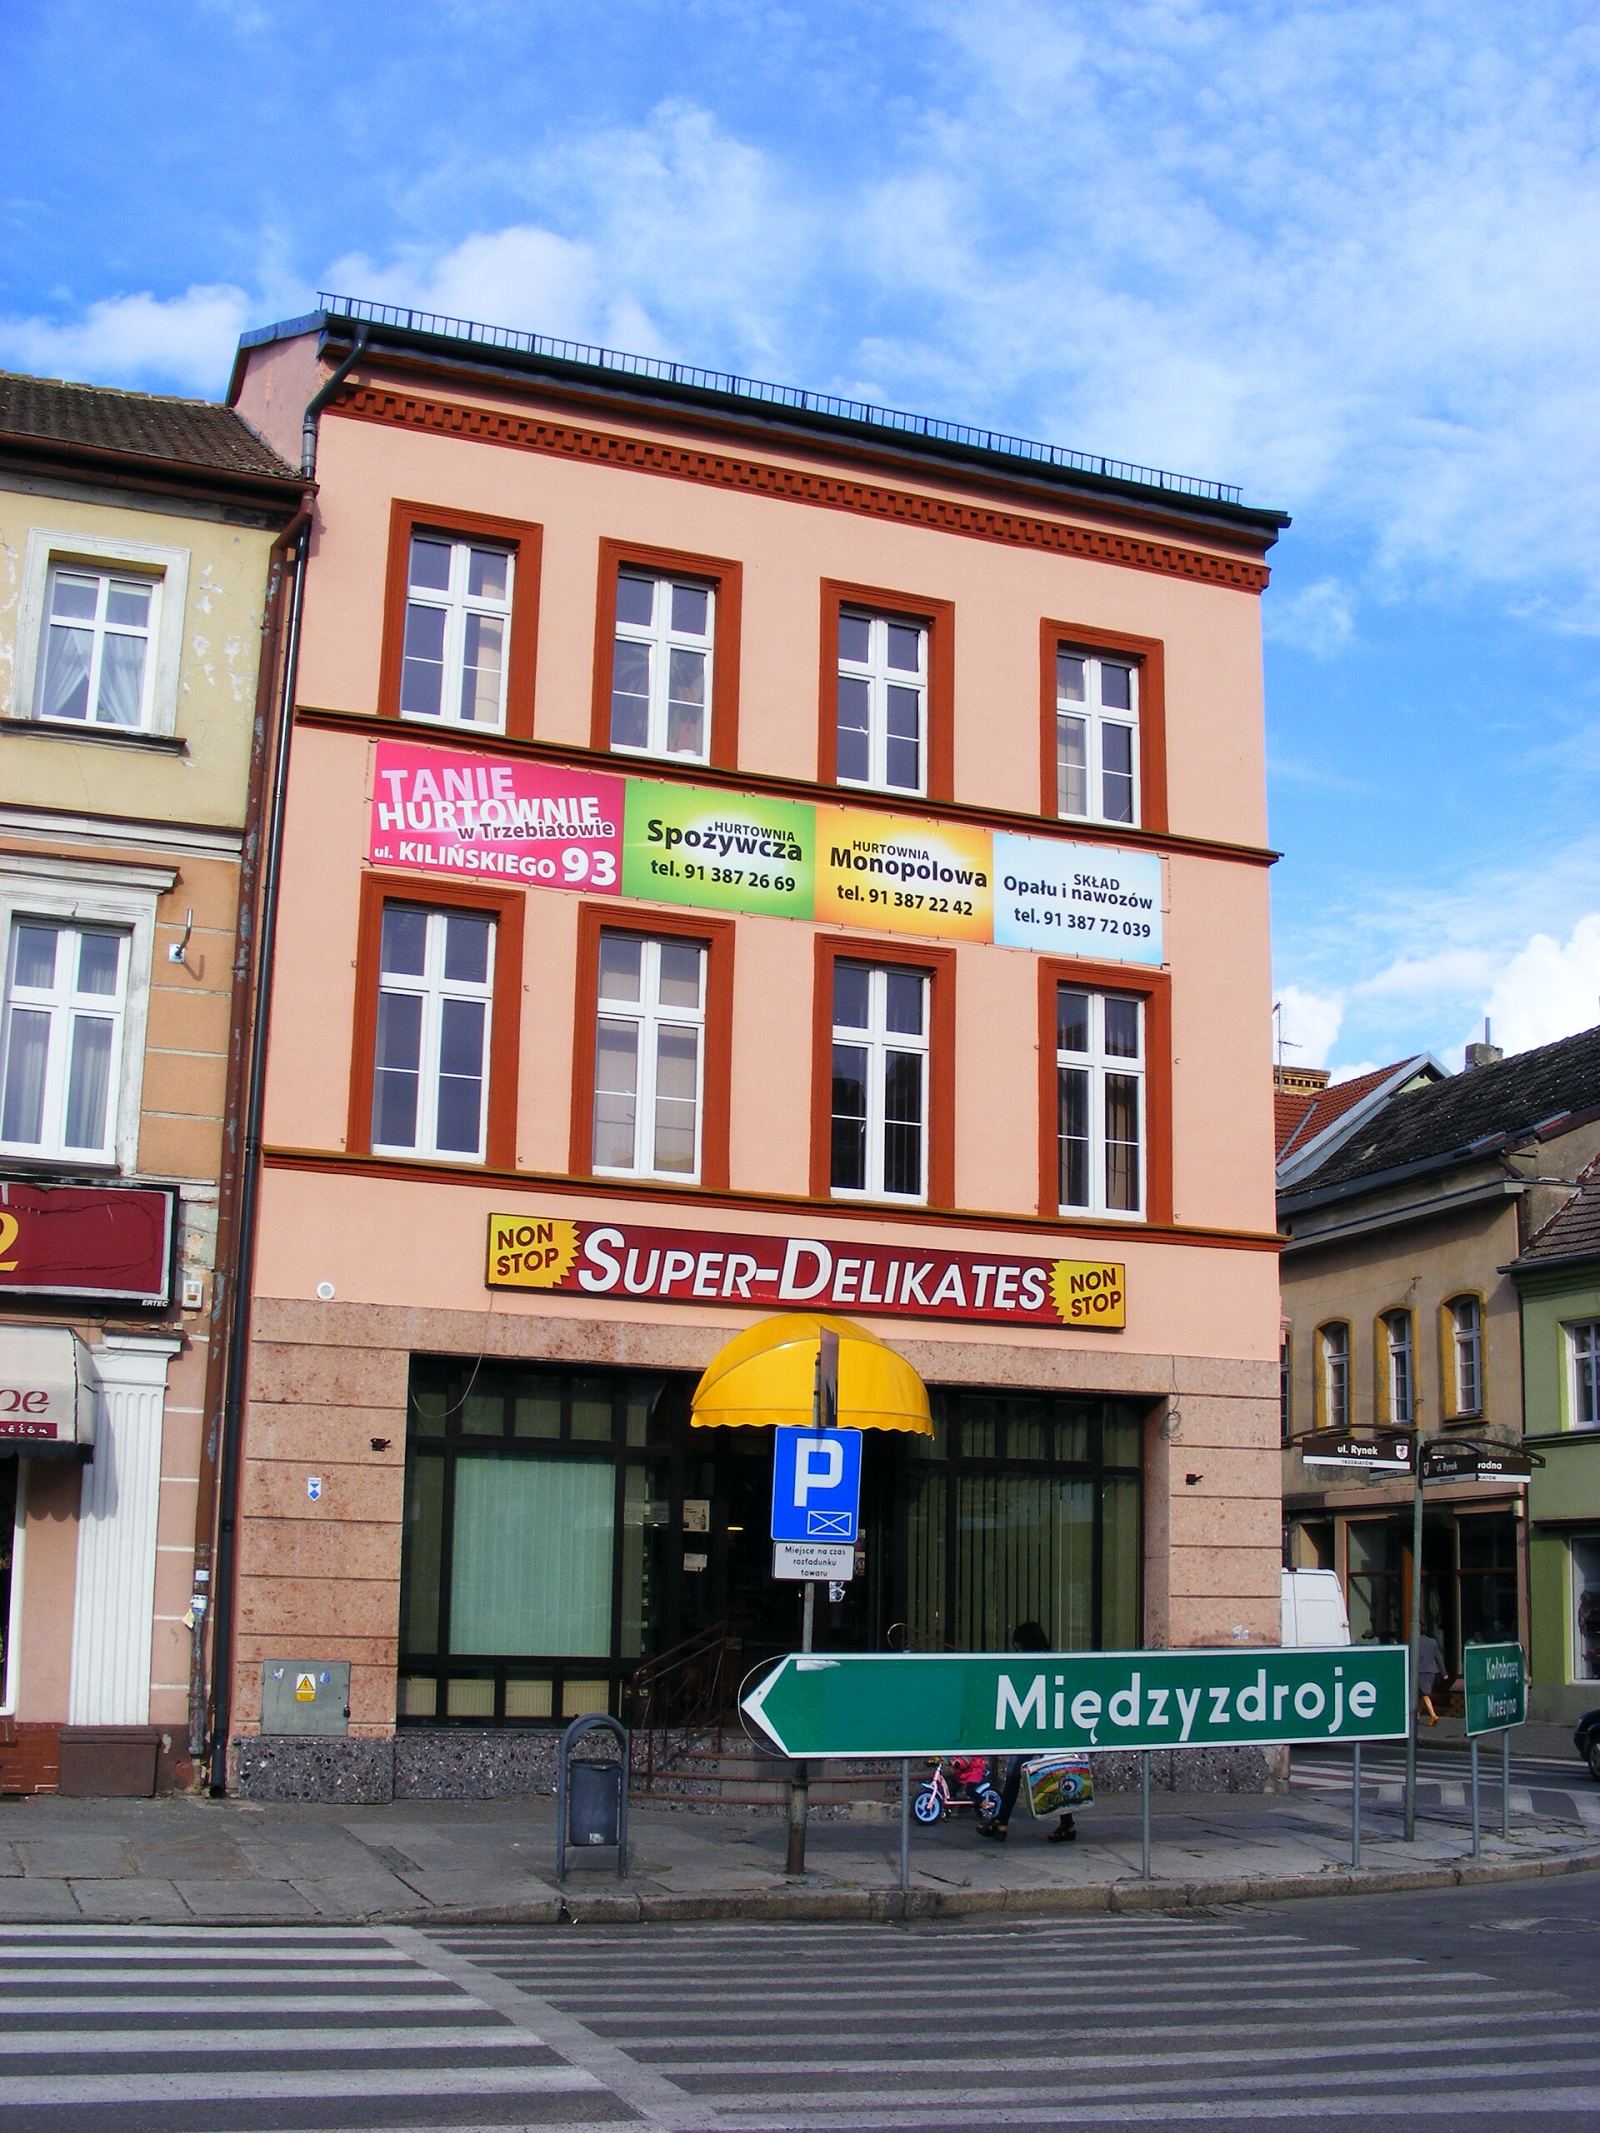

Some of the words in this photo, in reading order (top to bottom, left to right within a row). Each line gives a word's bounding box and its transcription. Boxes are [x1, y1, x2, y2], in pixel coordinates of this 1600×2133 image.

[381, 767, 516, 803] TANIE
[378, 797, 600, 831] HURTOWNIE
[458, 827, 474, 840] w
[480, 820, 613, 839] Trzebiatowie
[647, 819, 802, 861] Spożywcza
[714, 821, 795, 842] HURTOWNIA
[374, 845, 393, 859] ul.
[400, 841, 556, 878] KILIŃSKIEGO
[561, 847, 617, 886] 93
[852, 840, 930, 861] HURTOWNIA
[651, 860, 680, 877] tel.
[684, 864, 705, 880] 91
[711, 867, 743, 885] 387
[748, 872, 770, 889] 26
[774, 876, 796, 892] 69
[830, 847, 987, 888] Monopolowa
[1074, 874, 1120, 891] SKŁAD
[837, 885, 864, 902] tel.
[869, 888, 888, 904] 91
[894, 892, 924, 909] 387
[929, 897, 949, 913] 22
[953, 900, 973, 916] 42
[1003, 875, 1057, 896] Opału
[1062, 883, 1067, 898] i
[1071, 886, 1153, 910] nawozów
[1014, 907, 1040, 924] tel.
[1044, 911, 1061, 926] 91
[1067, 914, 1096, 931] 387
[1100, 918, 1119, 934] 72
[1122, 921, 1151, 938] 039
[497, 1222, 554, 1251] NON
[496, 1247, 560, 1277] STOP
[577, 1227, 1047, 1311] SUPER-DELIKATES
[1070, 1267, 1117, 1294] NON
[1071, 1290, 1122, 1318] STOP
[1337, 1444, 1348, 1454] ul.
[1351, 1444, 1378, 1456] Rynek
[793, 1438, 844, 1507] P
[785, 1546, 815, 1556] Miejsce
[829, 1548, 846, 1556] czas
[793, 1558, 837, 1566] rozładunku
[1485, 1656, 1520, 1684] Kołobrzeg
[994, 1666, 1377, 1745] Międzyzdroje
[1487, 1692, 1517, 1721] Mrzeżyno
